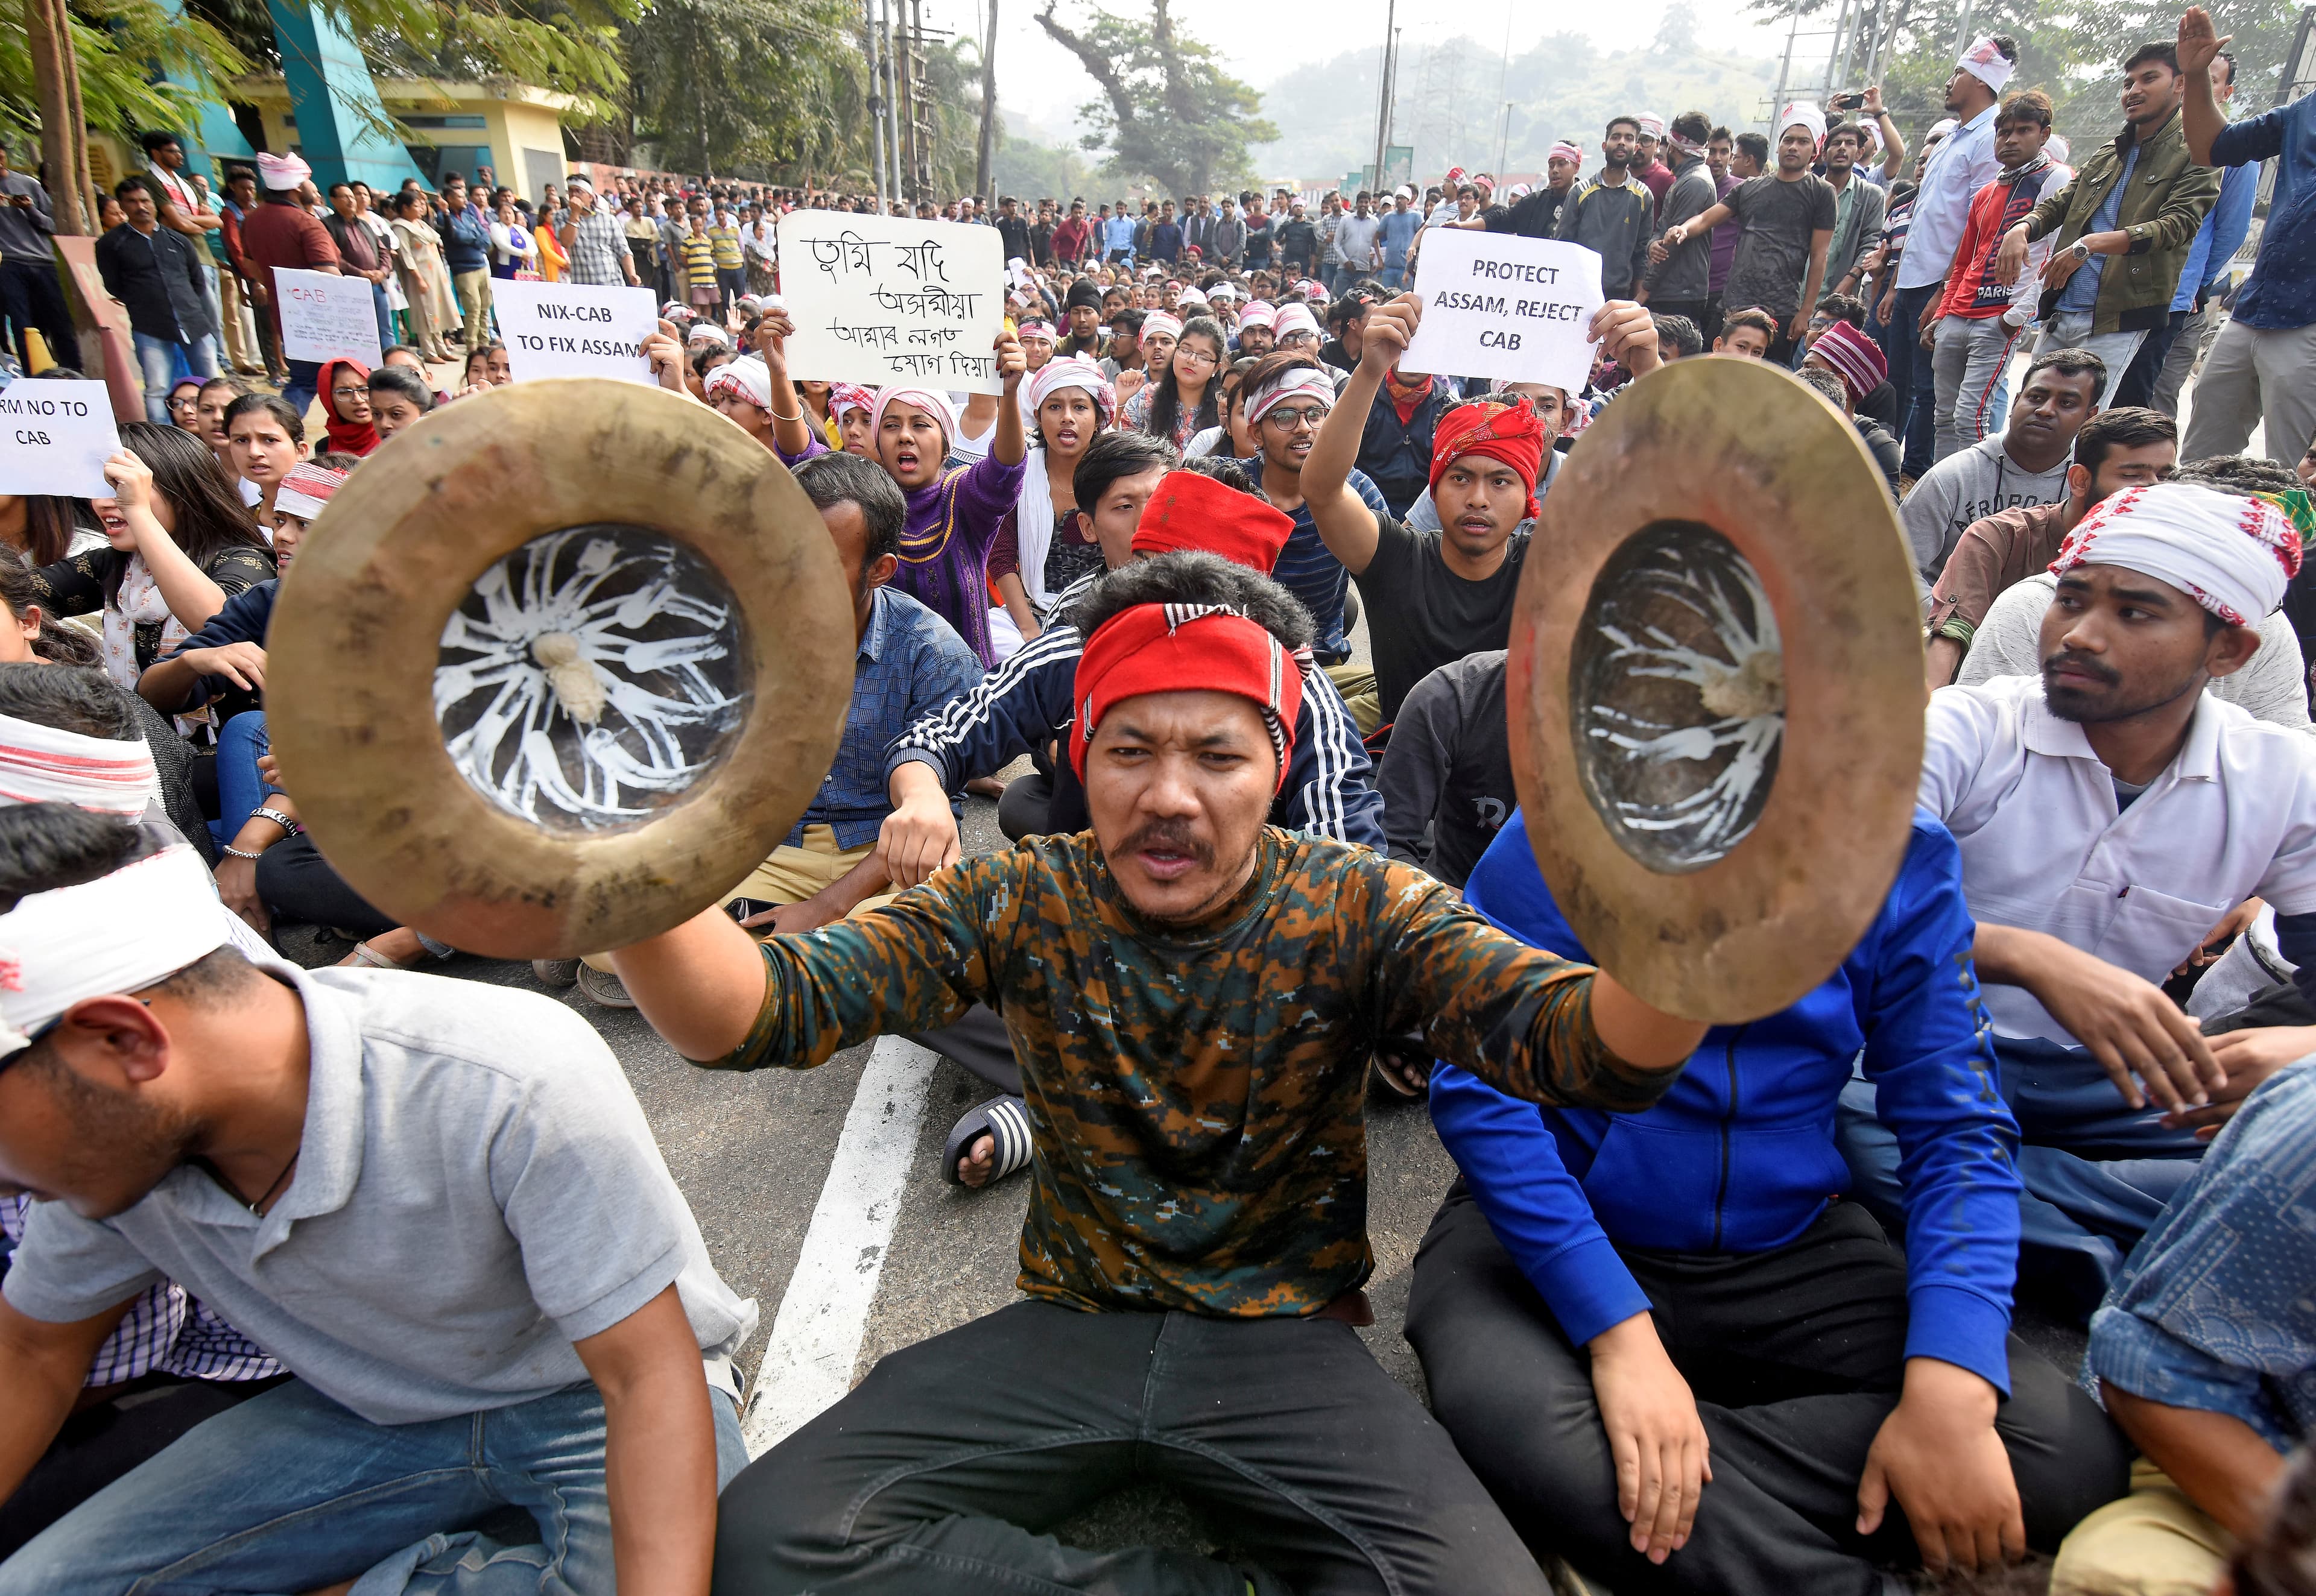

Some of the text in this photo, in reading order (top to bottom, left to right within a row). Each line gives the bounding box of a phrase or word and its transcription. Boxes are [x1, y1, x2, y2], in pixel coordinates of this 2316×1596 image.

[800, 231, 949, 284] তুমি যদি
[1472, 259, 1560, 285] PROTECT
[292, 289, 326, 303] CAB
[1978, 286, 2013, 299] PARIS
[537, 303, 612, 323] NIX-CAB
[1434, 291, 1584, 322] ASSAM, REJECT
[517, 335, 640, 358] TO FIX ASSAM
[908, 327, 963, 348] লগত
[1479, 330, 1521, 351] CAB
[883, 355, 944, 377] যোগ
[27, 400, 55, 415] NO
[60, 401, 88, 417] TO
[16, 430, 51, 445] CAB
